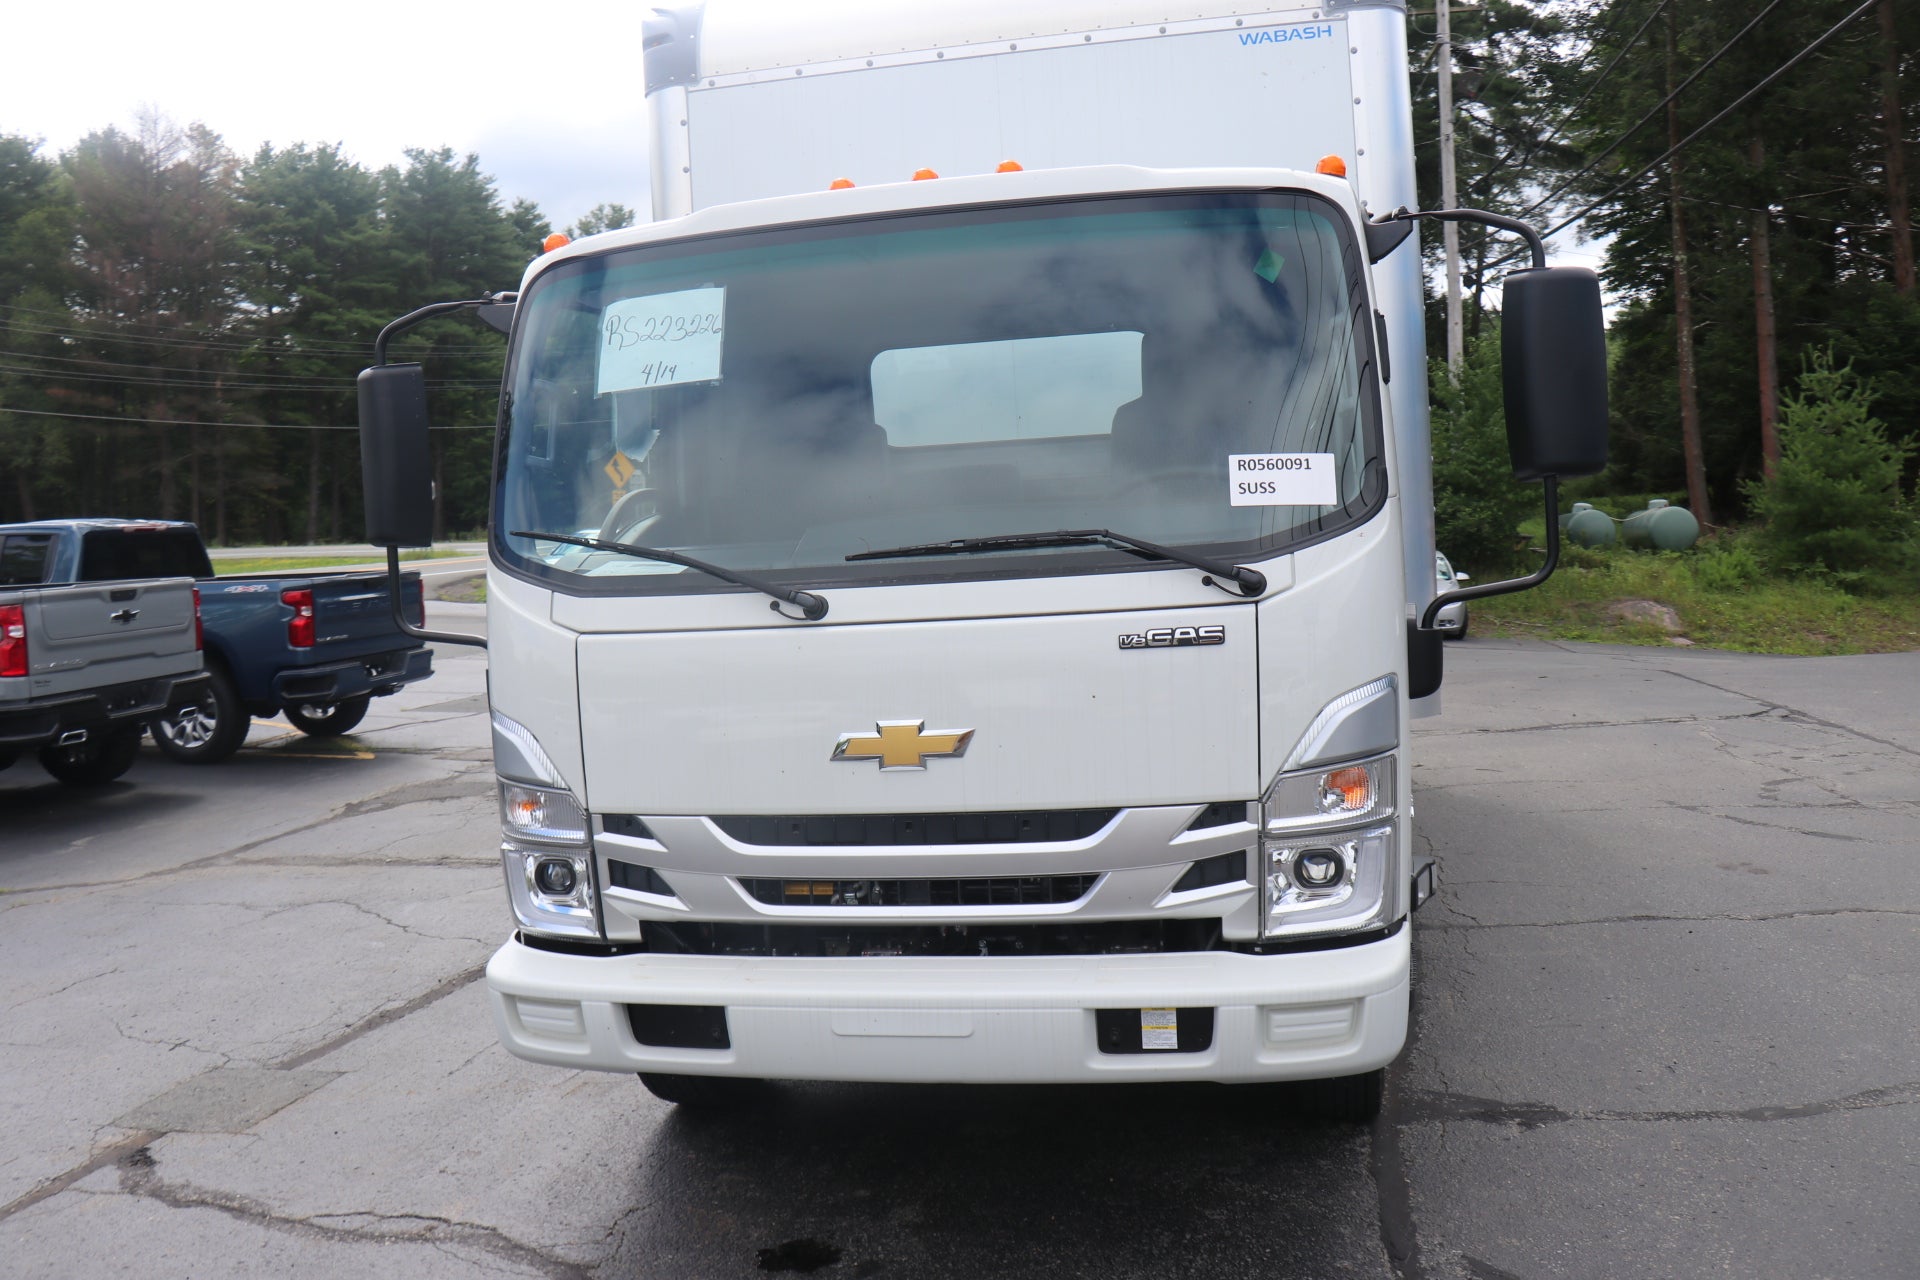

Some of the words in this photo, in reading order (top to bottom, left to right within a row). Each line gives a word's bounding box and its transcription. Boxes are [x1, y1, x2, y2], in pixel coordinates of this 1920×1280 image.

[1239, 25, 1332, 46] WABASH
[1237, 458, 1312, 471] R0560091
[1238, 481, 1276, 495] SUSS
[1146, 625, 1225, 646] GAS
